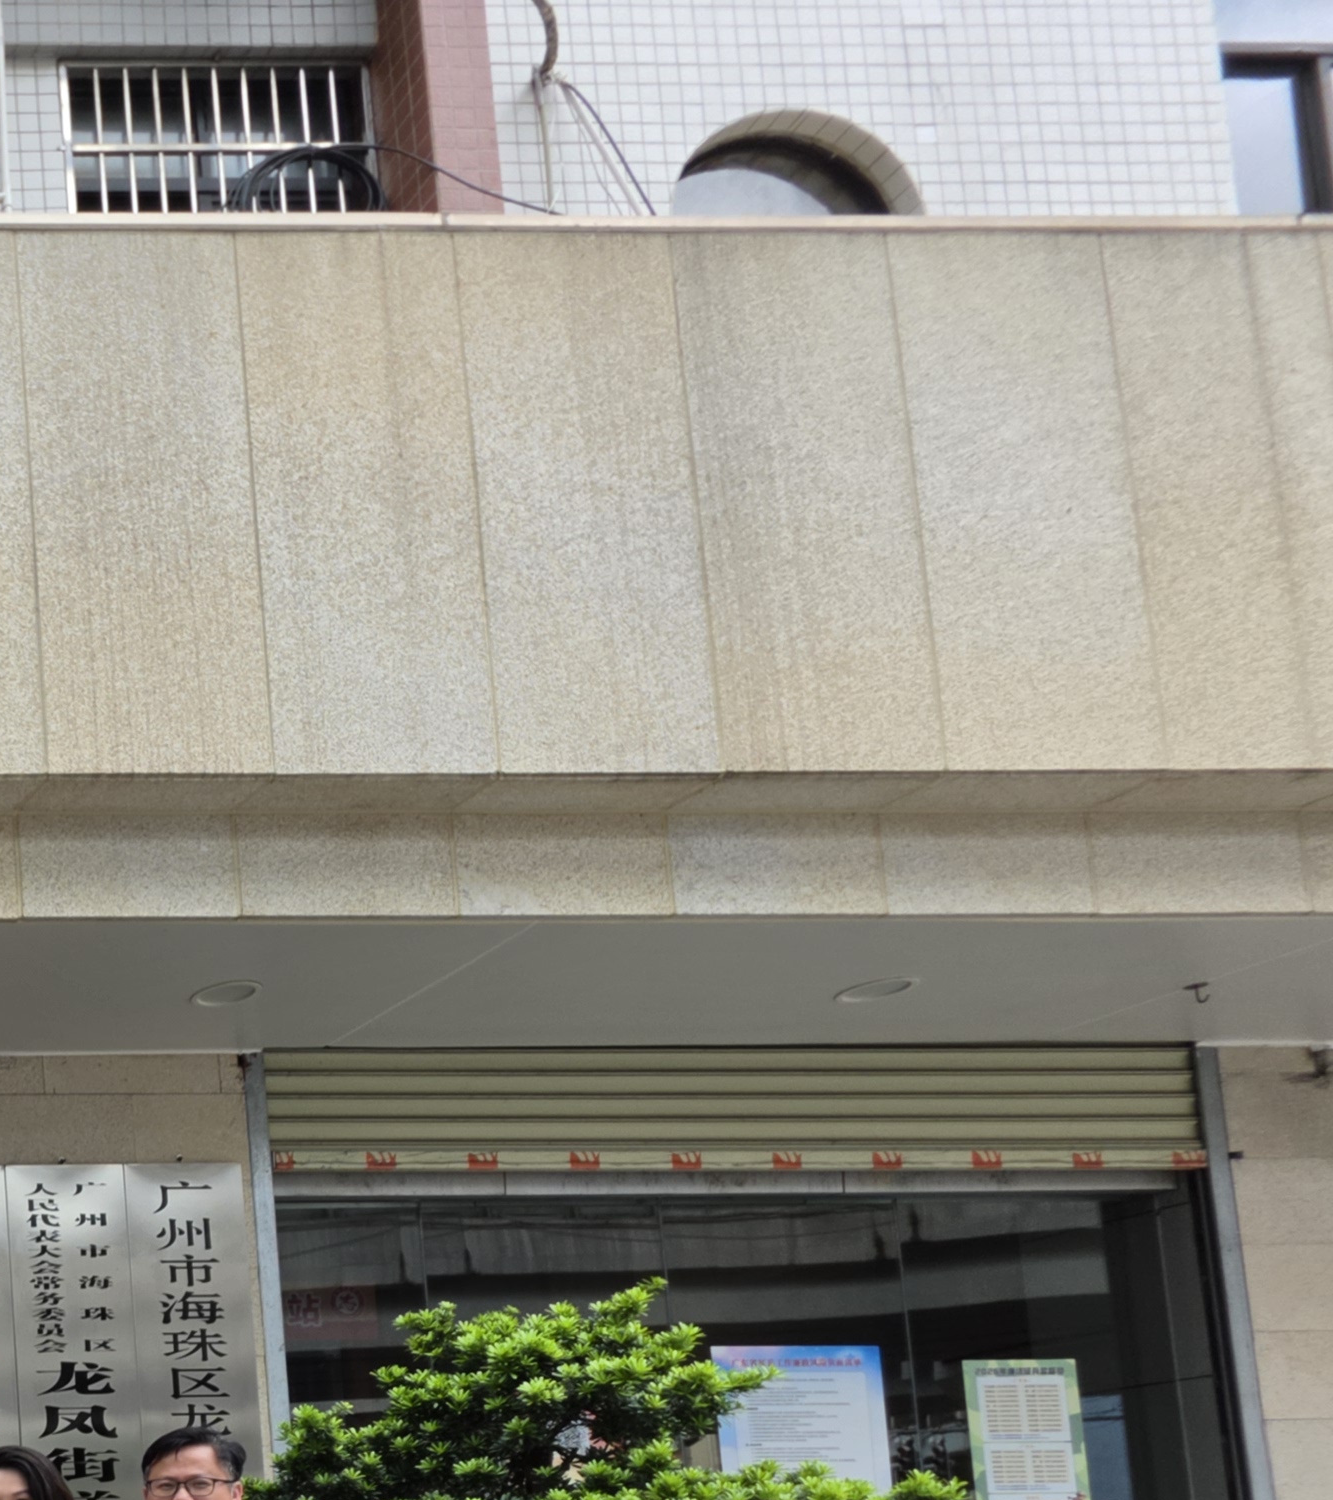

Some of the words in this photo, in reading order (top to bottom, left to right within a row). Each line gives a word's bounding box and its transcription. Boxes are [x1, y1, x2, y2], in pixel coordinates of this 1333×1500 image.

[24, 1182, 69, 1354] 人民代表大会常务委员会
[72, 1181, 118, 1353] 广州市海珠区
